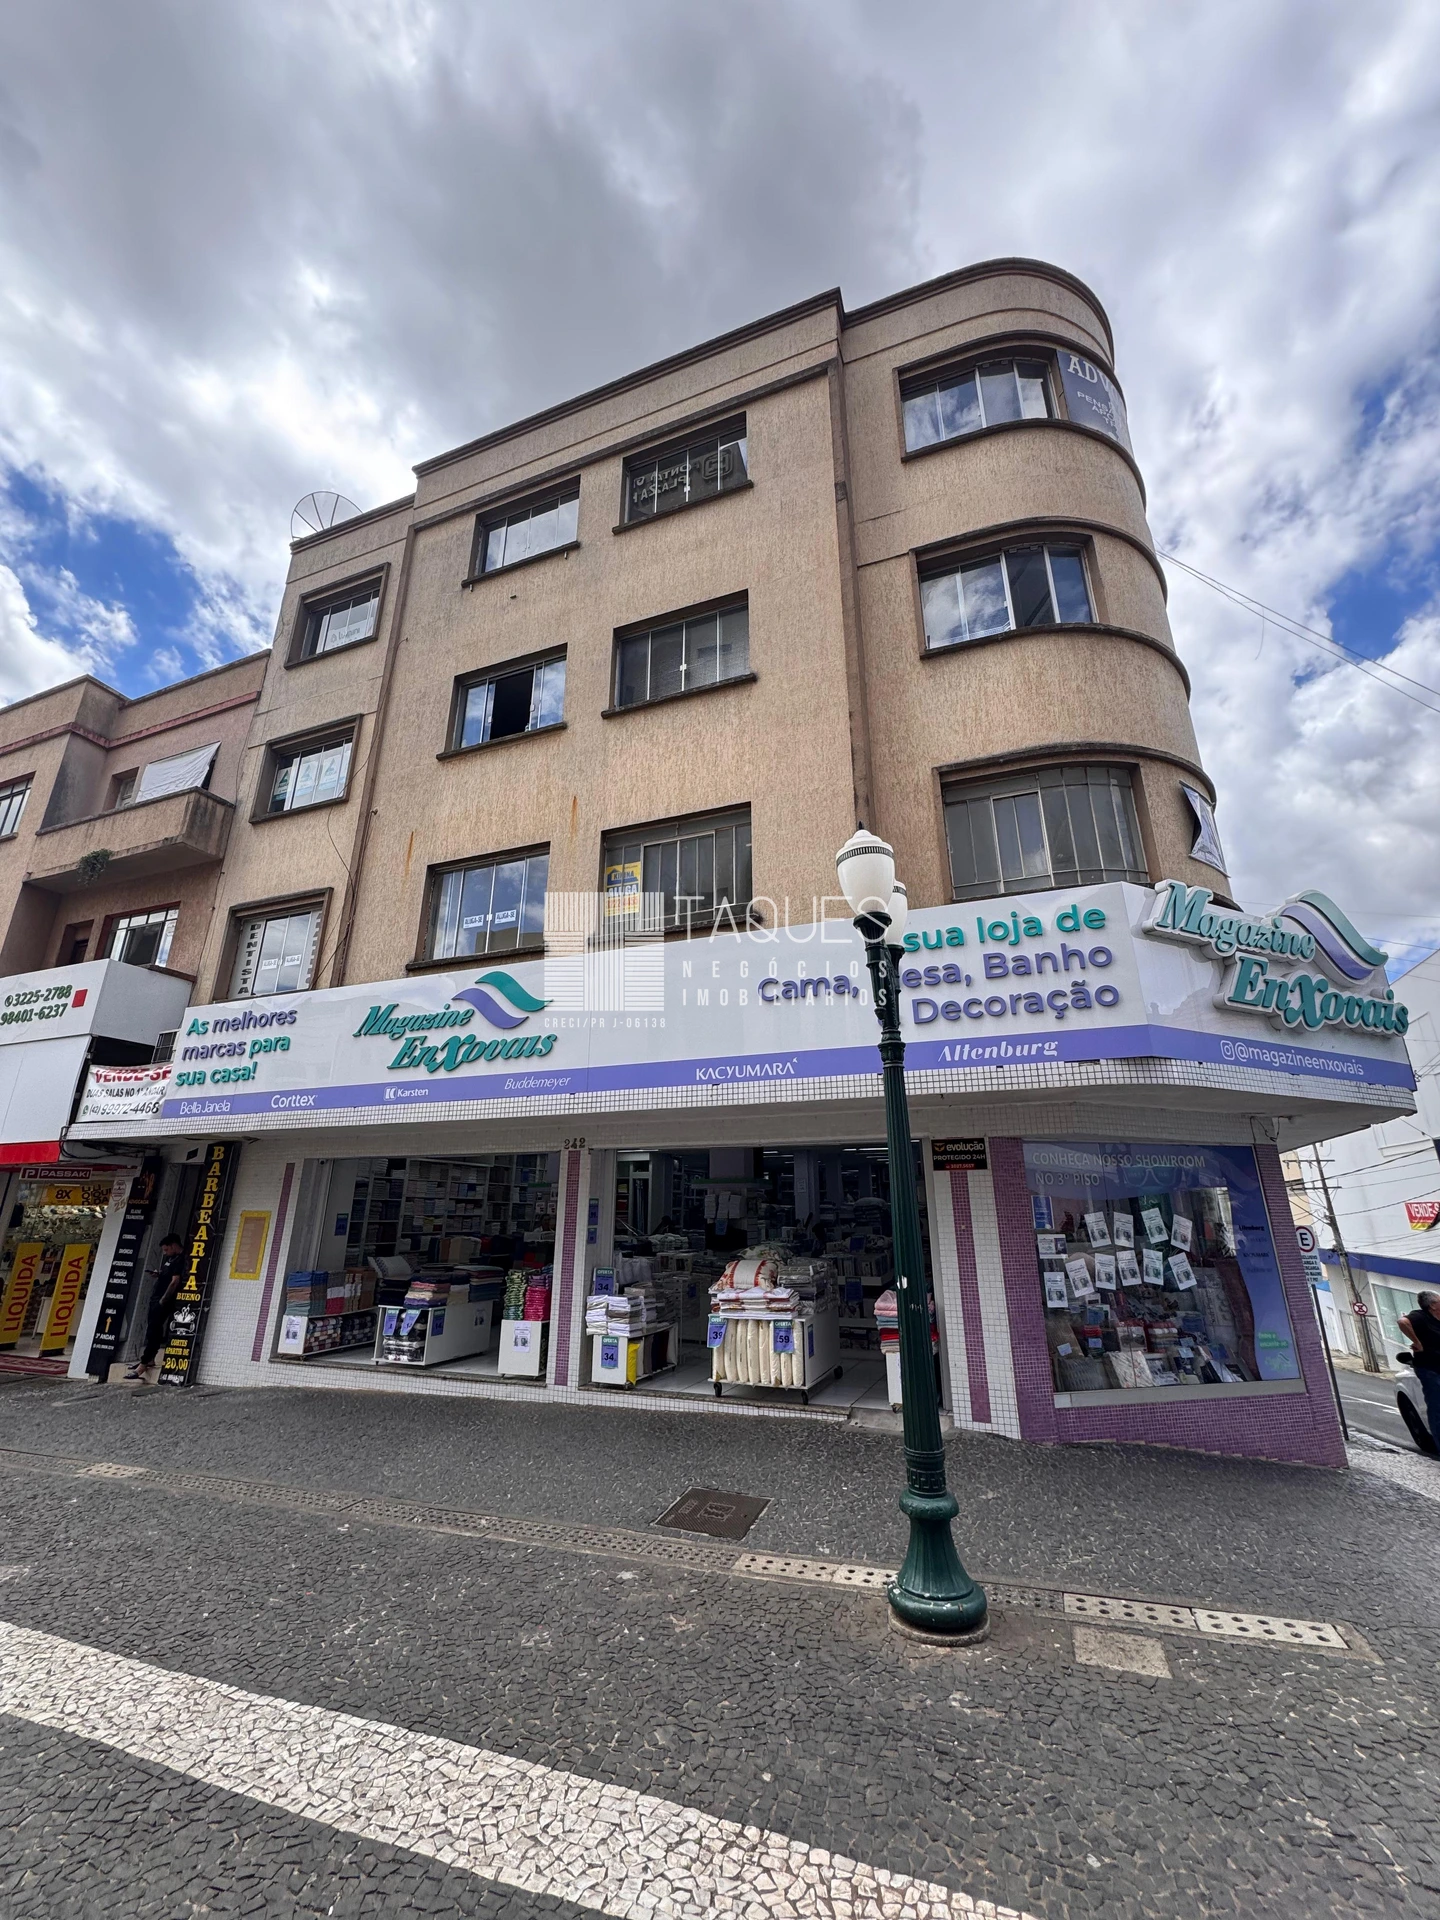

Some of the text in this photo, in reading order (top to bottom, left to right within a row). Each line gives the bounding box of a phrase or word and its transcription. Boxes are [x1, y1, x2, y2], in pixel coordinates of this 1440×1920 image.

[464, 916, 483, 926] ALUGA-SE
[496, 910, 515, 921] ALUGA-SE
[902, 902, 1106, 952] sua loja de
[1156, 882, 1316, 959] Magazine
[238, 923, 262, 995] DENTISTA
[758, 942, 1114, 1002] Cama, esa, Banho
[12, 984, 73, 1007] 3225-2788
[911, 980, 1120, 1025] Decoração
[1228, 955, 1410, 1034] EnXovais
[0, 1003, 68, 1026] 98401-6237
[186, 1009, 298, 1036] As melhores
[352, 1003, 475, 1041] Magazine
[181, 1035, 291, 1061] marcas para
[938, 1039, 1059, 1063] Altenburg
[1236, 1042, 1364, 1076] @magazineenxovais
[175, 1061, 258, 1087] sua casa!
[504, 1076, 571, 1091] Buddemeyer
[105, 1087, 124, 1098] SALAS
[125, 1087, 135, 1097] NO
[271, 1094, 315, 1108] Corttex
[397, 1088, 428, 1098] Karsten
[180, 1100, 231, 1115] Bella Janela
[564, 1137, 587, 1150] 242
[946, 1141, 985, 1152] evolução
[1032, 1152, 1206, 1168] CONHEÇA NOSSO SHOWROOM
[41, 1169, 90, 1178] PASSAKI
[1035, 1172, 1054, 1185] NO
[1073, 1173, 1100, 1186] PISO
[55, 1189, 73, 1200] 8X
[183, 1145, 225, 1292] BARBEARIA
[1299, 1232, 1310, 1246] E
[4, 1254, 38, 1332] LIQUIDA
[50, 1256, 84, 1338] LIQUIDA
[176, 1292, 201, 1301] BUENO
[99, 1333, 115, 1341] ANDAR
